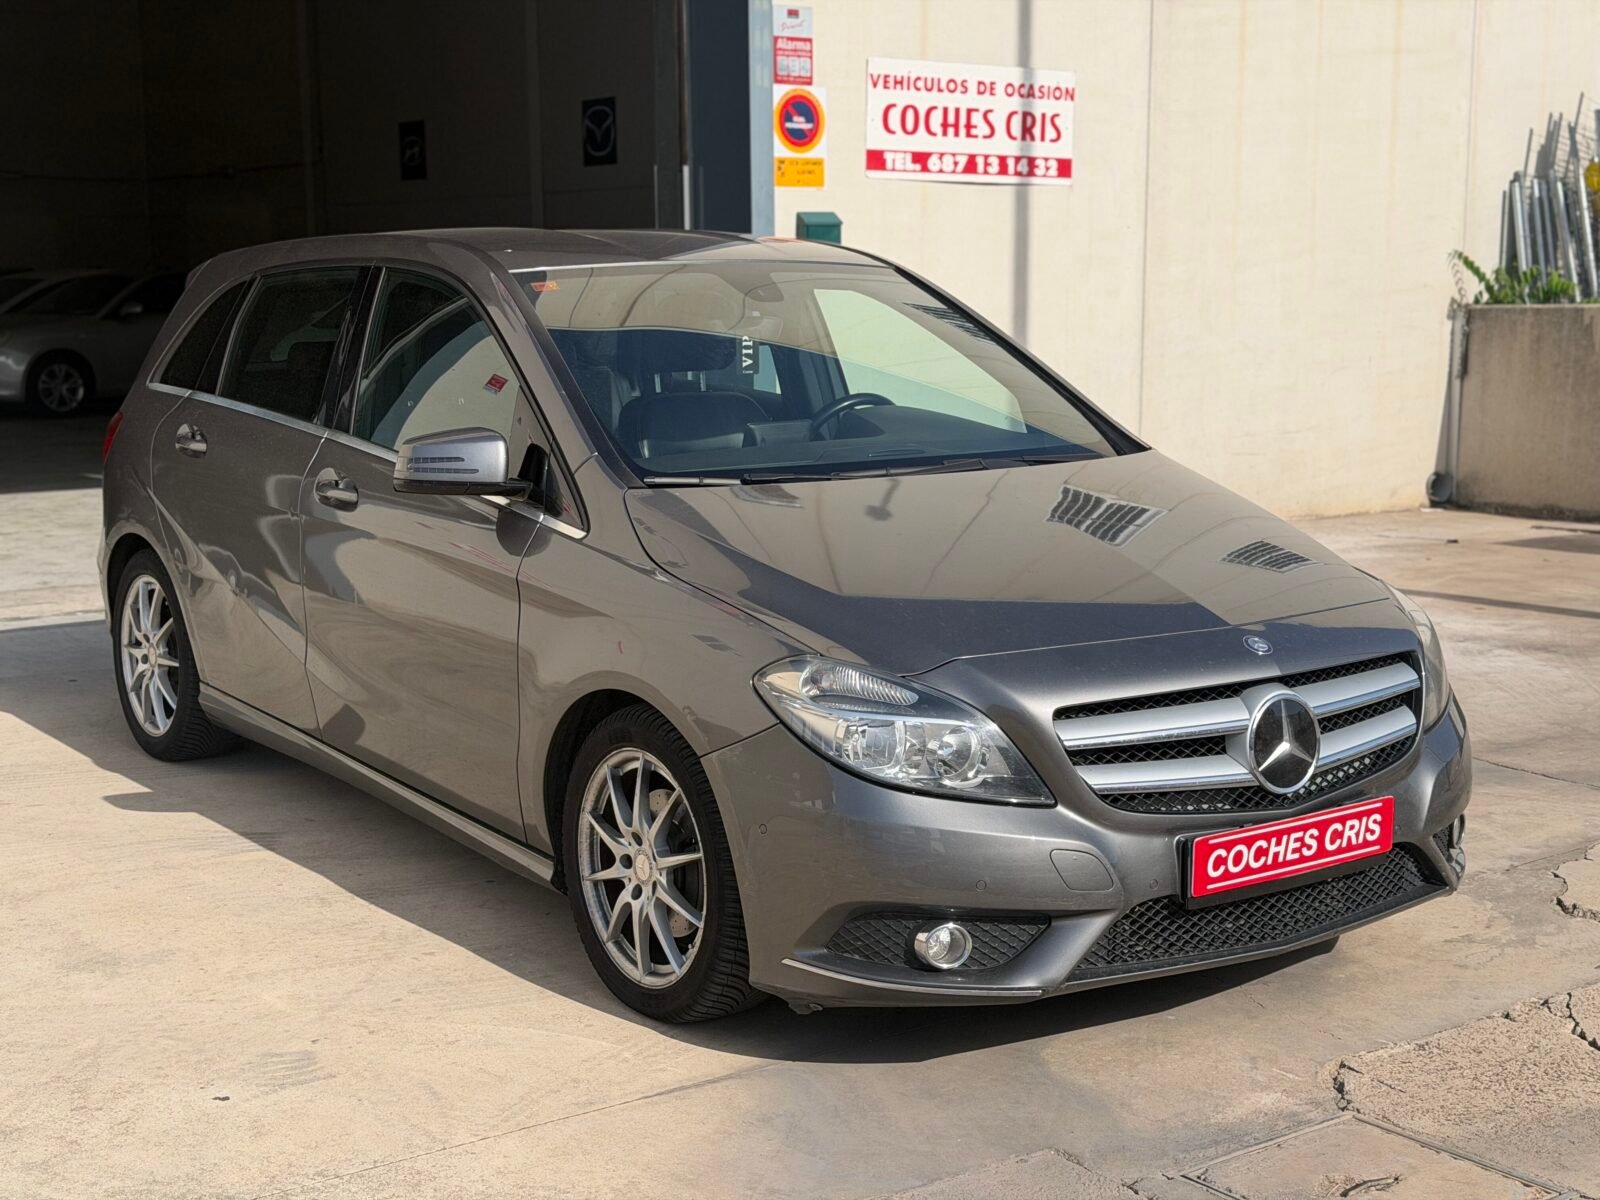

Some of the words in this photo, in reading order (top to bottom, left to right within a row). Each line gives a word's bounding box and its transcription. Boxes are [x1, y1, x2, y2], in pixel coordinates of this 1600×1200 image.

[870, 71, 968, 94] VEHÍCULOS
[977, 80, 997, 96] DE
[1004, 81, 1076, 102] OCASIÓN
[882, 103, 996, 139] COCHES
[1005, 110, 1062, 143] CRIS
[883, 151, 922, 172] TEL.
[927, 153, 968, 173] 687
[975, 156, 1000, 174] 13
[1006, 157, 1030, 176] 14
[1033, 158, 1059, 177] 32
[742, 335, 753, 368] VIP
[1206, 828, 1319, 878] COCHES
[1324, 813, 1383, 851] CRIS
